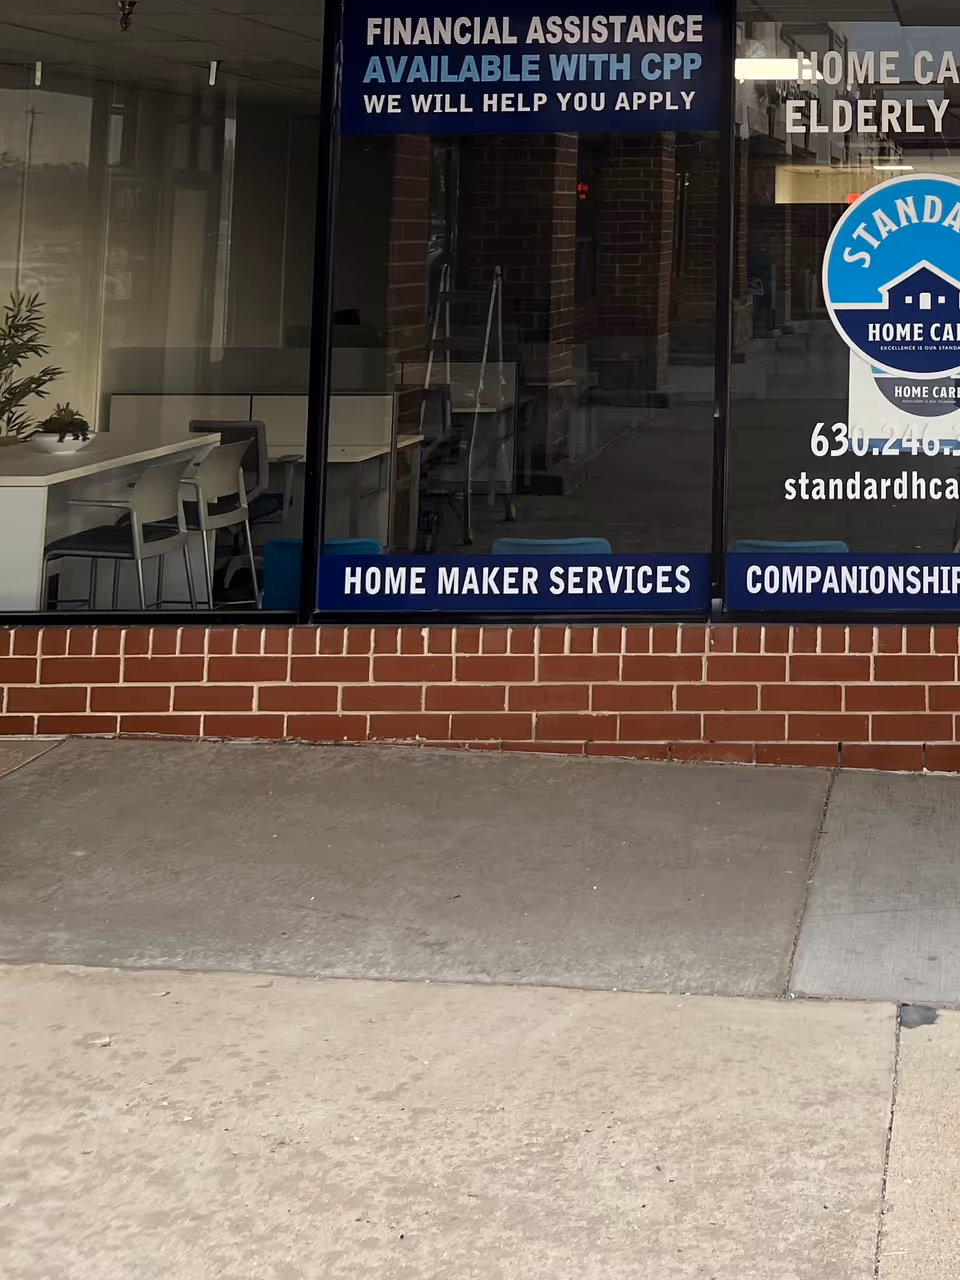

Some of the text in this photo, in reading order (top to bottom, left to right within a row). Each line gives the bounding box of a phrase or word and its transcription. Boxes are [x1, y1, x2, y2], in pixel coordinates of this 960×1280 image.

[366, 14, 704, 46] FINANCIAL ASSISTANCE
[362, 52, 702, 84] AVAILABLE WITH CPP
[797, 51, 900, 85] HOME
[363, 90, 696, 114] WE WILL HELP YOU APPLY
[785, 99, 950, 134] ELDERLY
[868, 323, 924, 341] HOME
[894, 385, 929, 398] HOME
[344, 564, 691, 595] HOME MAKER SERVICES
